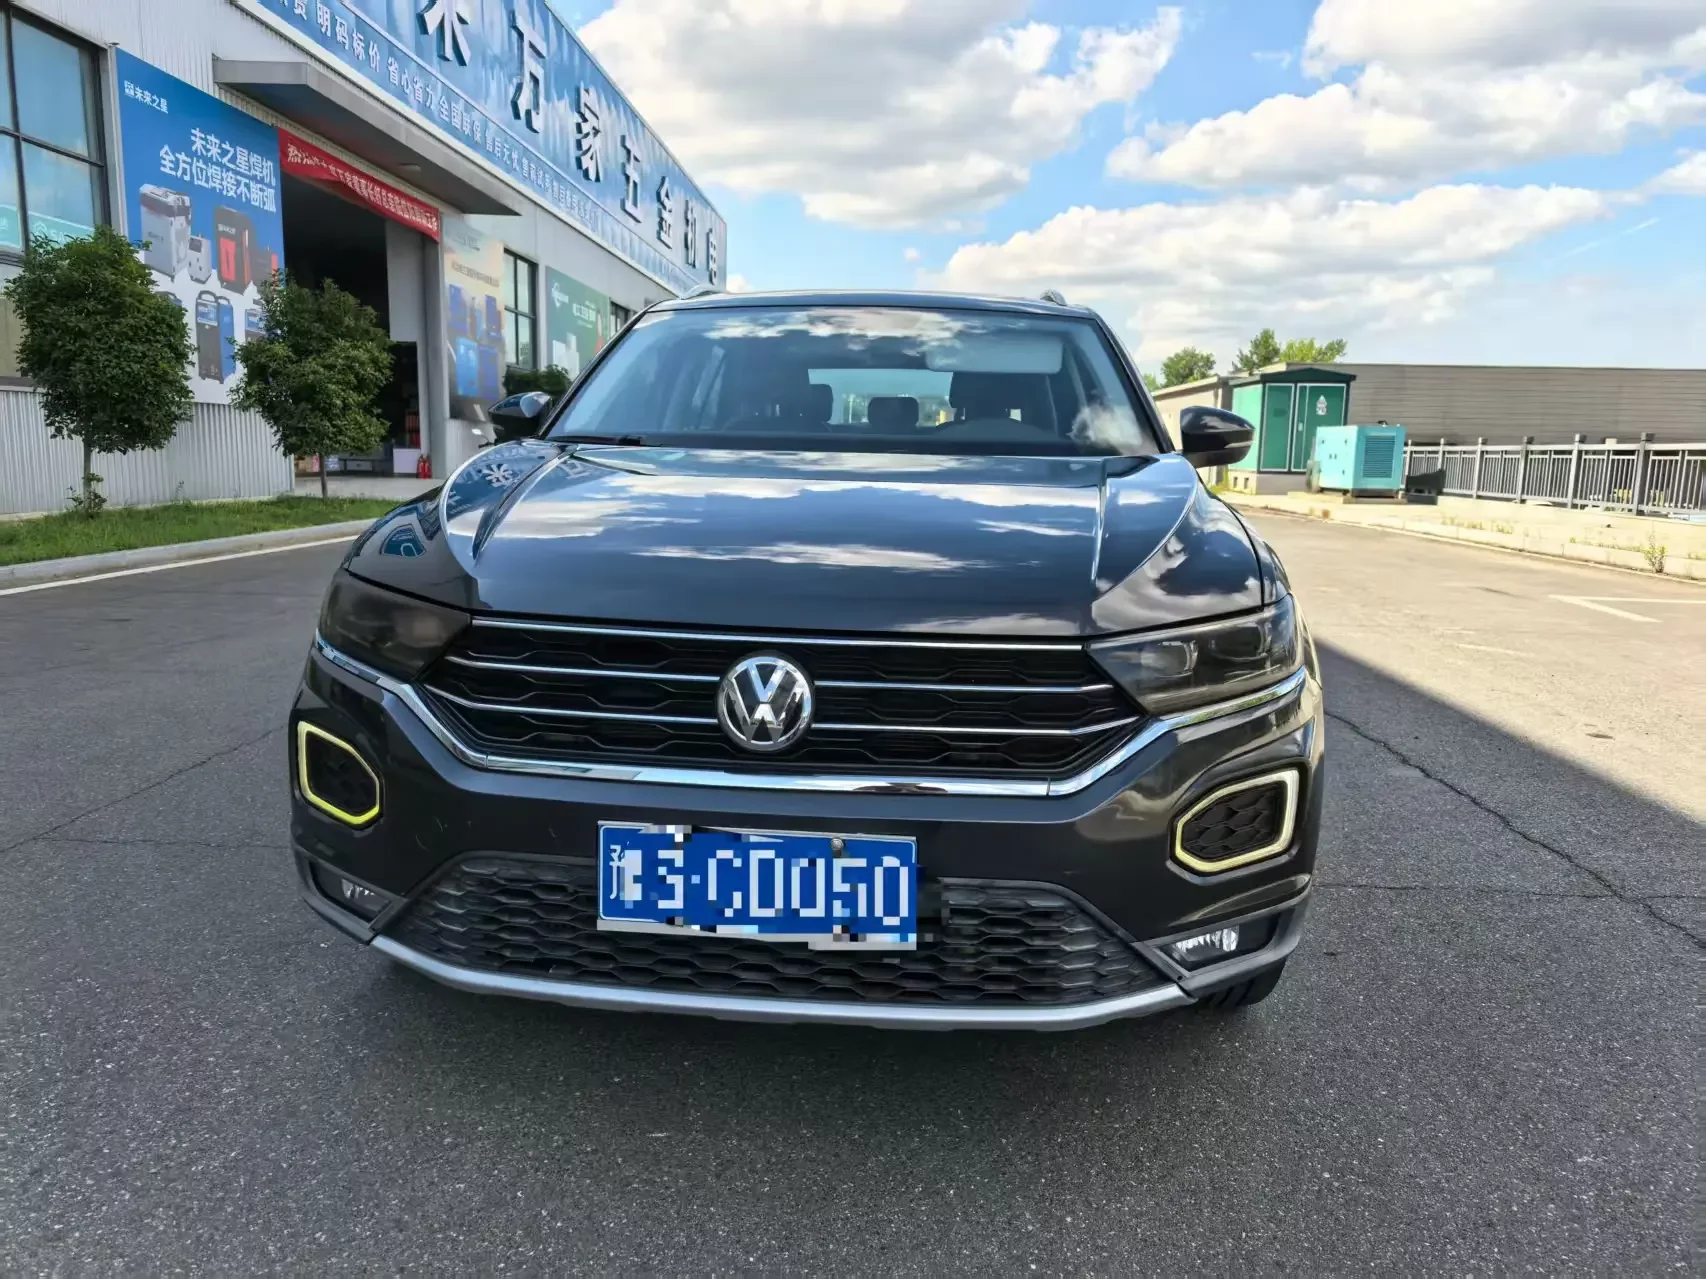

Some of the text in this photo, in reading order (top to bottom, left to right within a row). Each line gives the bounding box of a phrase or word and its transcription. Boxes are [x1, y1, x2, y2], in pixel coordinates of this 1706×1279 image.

[316, 3, 380, 73] 明码标价
[387, 57, 435, 111] 省心省力
[439, 95, 482, 145] 全国联保
[160, 144, 276, 213] 全方位焊接不断弧
[191, 127, 275, 187] 未来之星焊机
